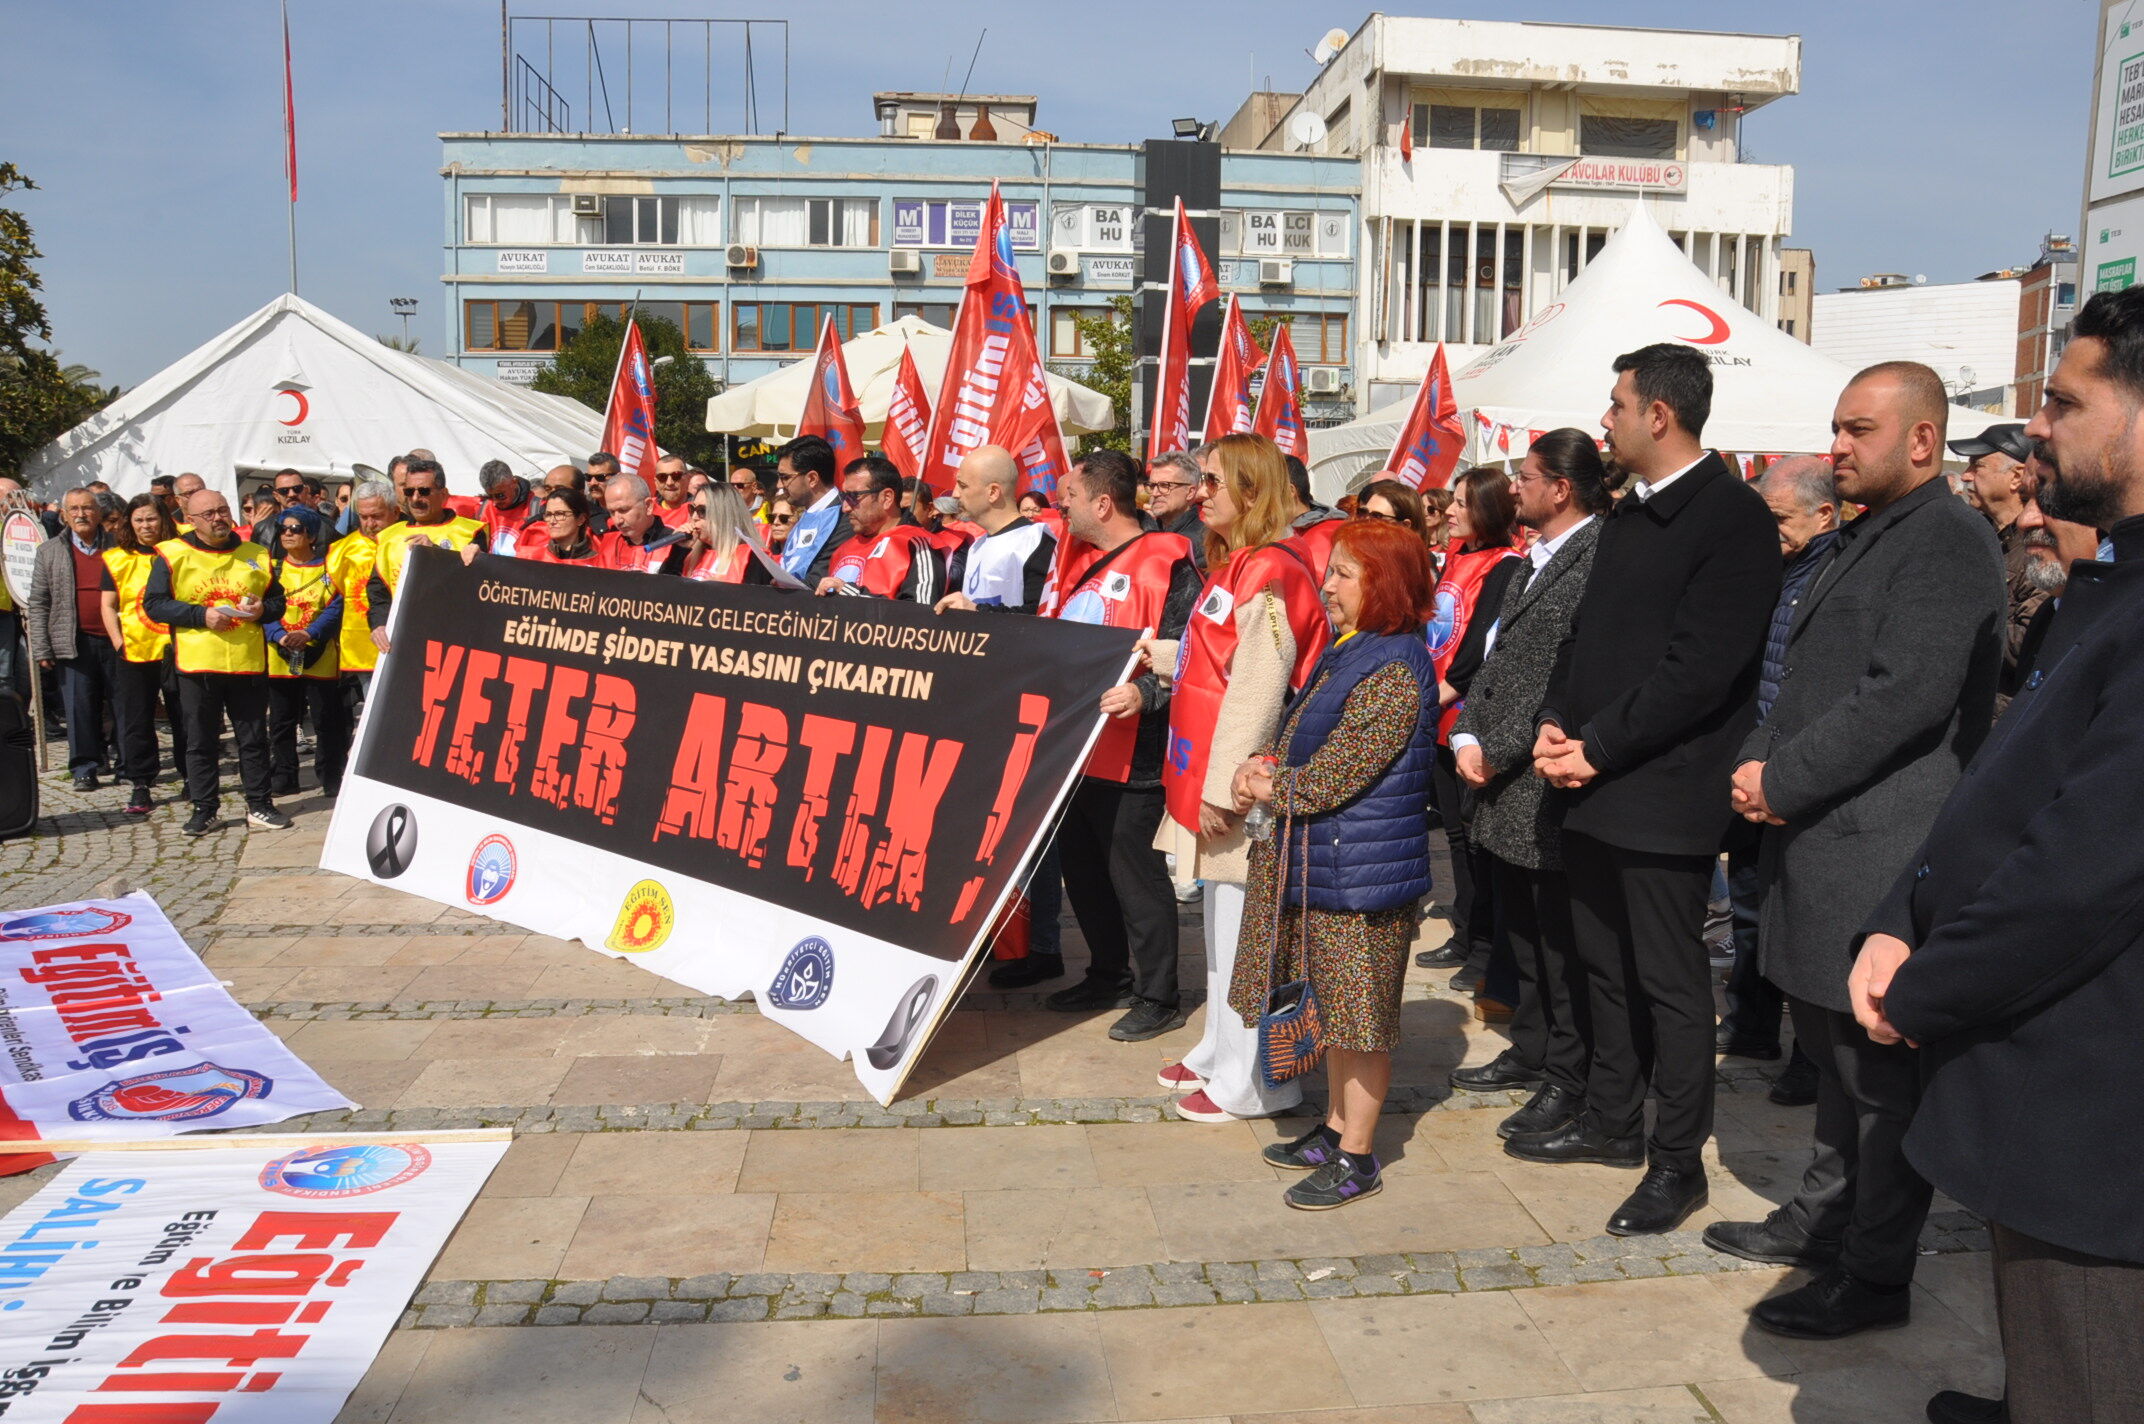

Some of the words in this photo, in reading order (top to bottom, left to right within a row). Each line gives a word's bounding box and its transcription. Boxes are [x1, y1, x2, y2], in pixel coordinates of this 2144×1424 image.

[1571, 163, 1615, 180] AVCILAR
[955, 210, 977, 218] DİLEK
[953, 219, 979, 228] KÜÇÜK
[500, 253, 545, 262] AVUKAT
[585, 253, 630, 262] AVUKAT
[638, 254, 683, 264] AVUKAT
[1092, 260, 1134, 270] AVUKAT
[277, 435, 311, 444] KIZILAY
[478, 580, 595, 615] ÖĞRETMENLERİ
[598, 597, 705, 627] KORURSANIZ
[708, 607, 839, 642] GELECEĞİNİZİ
[844, 621, 990, 657] KORURSUNUZ
[503, 615, 600, 656] EĞİTİMDE
[602, 626, 685, 666] ŞİDDET
[689, 643, 802, 685] YASASINI
[807, 658, 934, 701] ÇIKARTIN
[412, 639, 637, 825] YETER
[652, 692, 965, 912] ARTIK
[137, 1210, 220, 1267] Eğitim
[62, 1210, 402, 1424] Eğiti
[45, 1298, 135, 1352] Bilim
